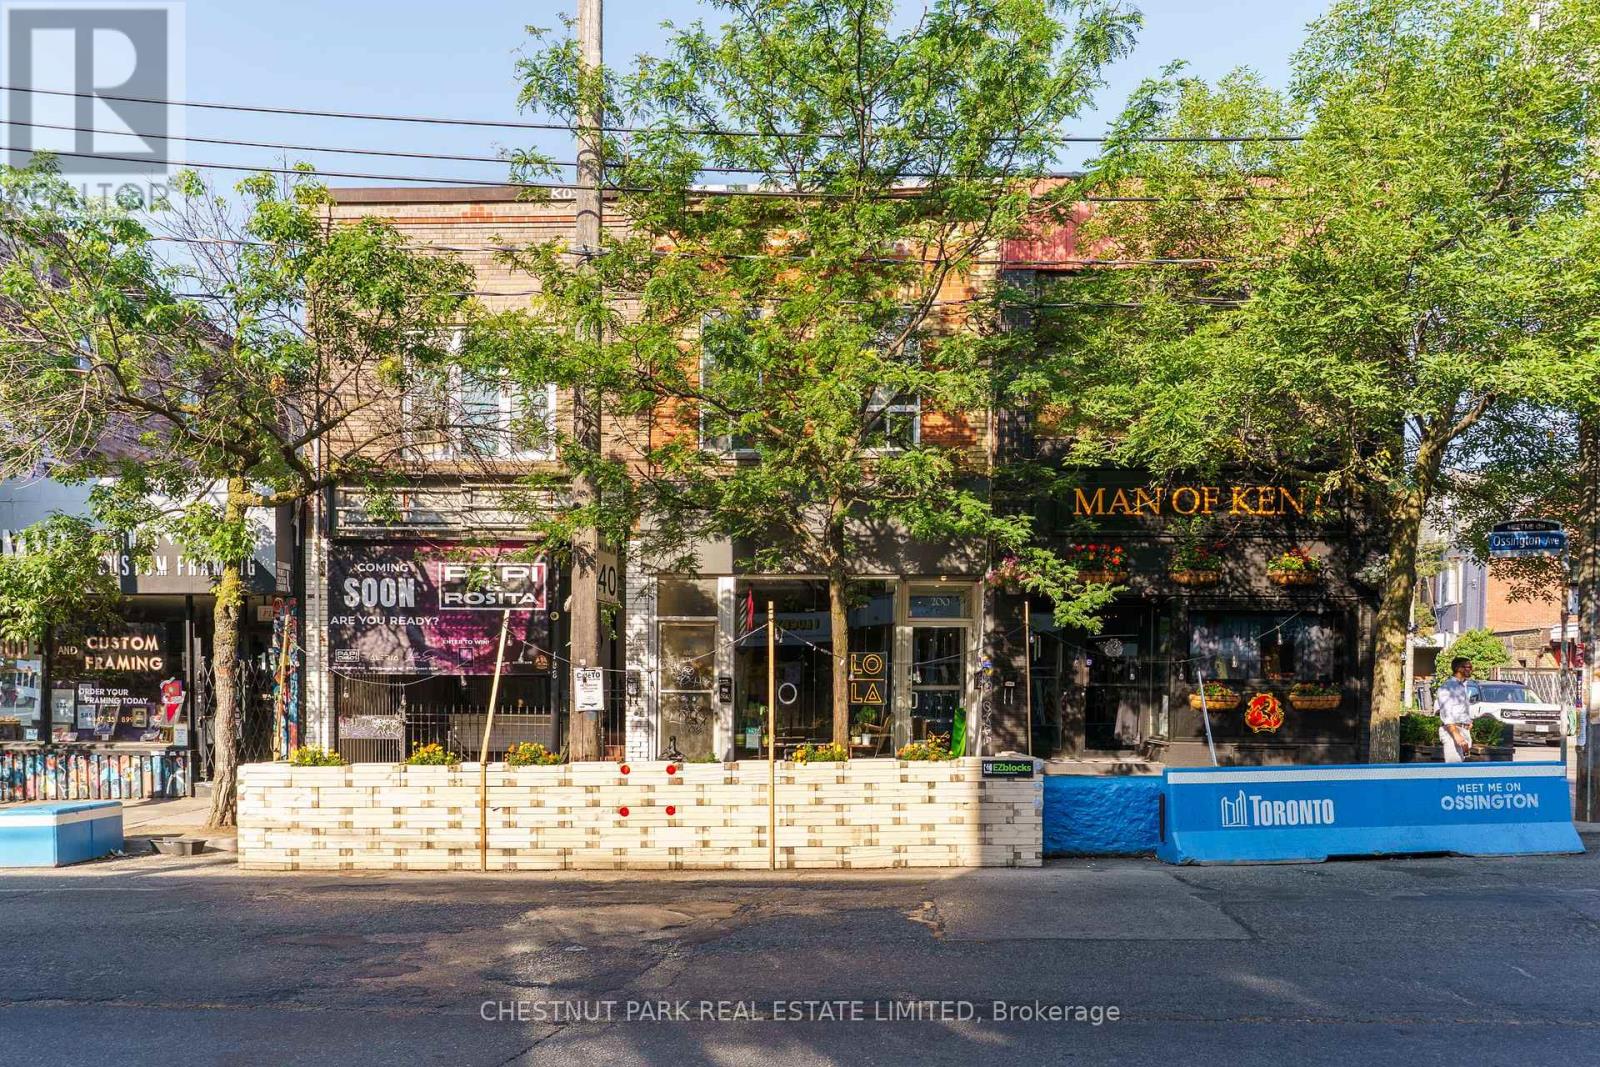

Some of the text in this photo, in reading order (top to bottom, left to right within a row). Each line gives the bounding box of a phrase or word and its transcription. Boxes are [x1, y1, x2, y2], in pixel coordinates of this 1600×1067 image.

[1073, 487, 1163, 515] MAN
[1172, 486, 1220, 515] OF
[1493, 535, 1541, 548] Ossington
[357, 563, 408, 572] COMING
[598, 564, 617, 596] 40
[344, 577, 415, 608] SOON
[445, 592, 539, 604] ROSITA
[330, 616, 355, 626] ARE
[359, 616, 386, 626] YOU
[390, 616, 440, 626] READY?
[86, 635, 159, 651] CUSTOM
[58, 645, 79, 656] AND
[84, 655, 164, 672] FRAMING
[850, 653, 883, 675] LO
[106, 688, 129, 696] YOUR
[850, 682, 883, 704] LA
[84, 697, 149, 705] FRAMING TODAY
[993, 763, 1031, 772] EZblocks
[1457, 782, 1521, 793] MEET ME ON
[1440, 793, 1540, 811] OSSINGTON
